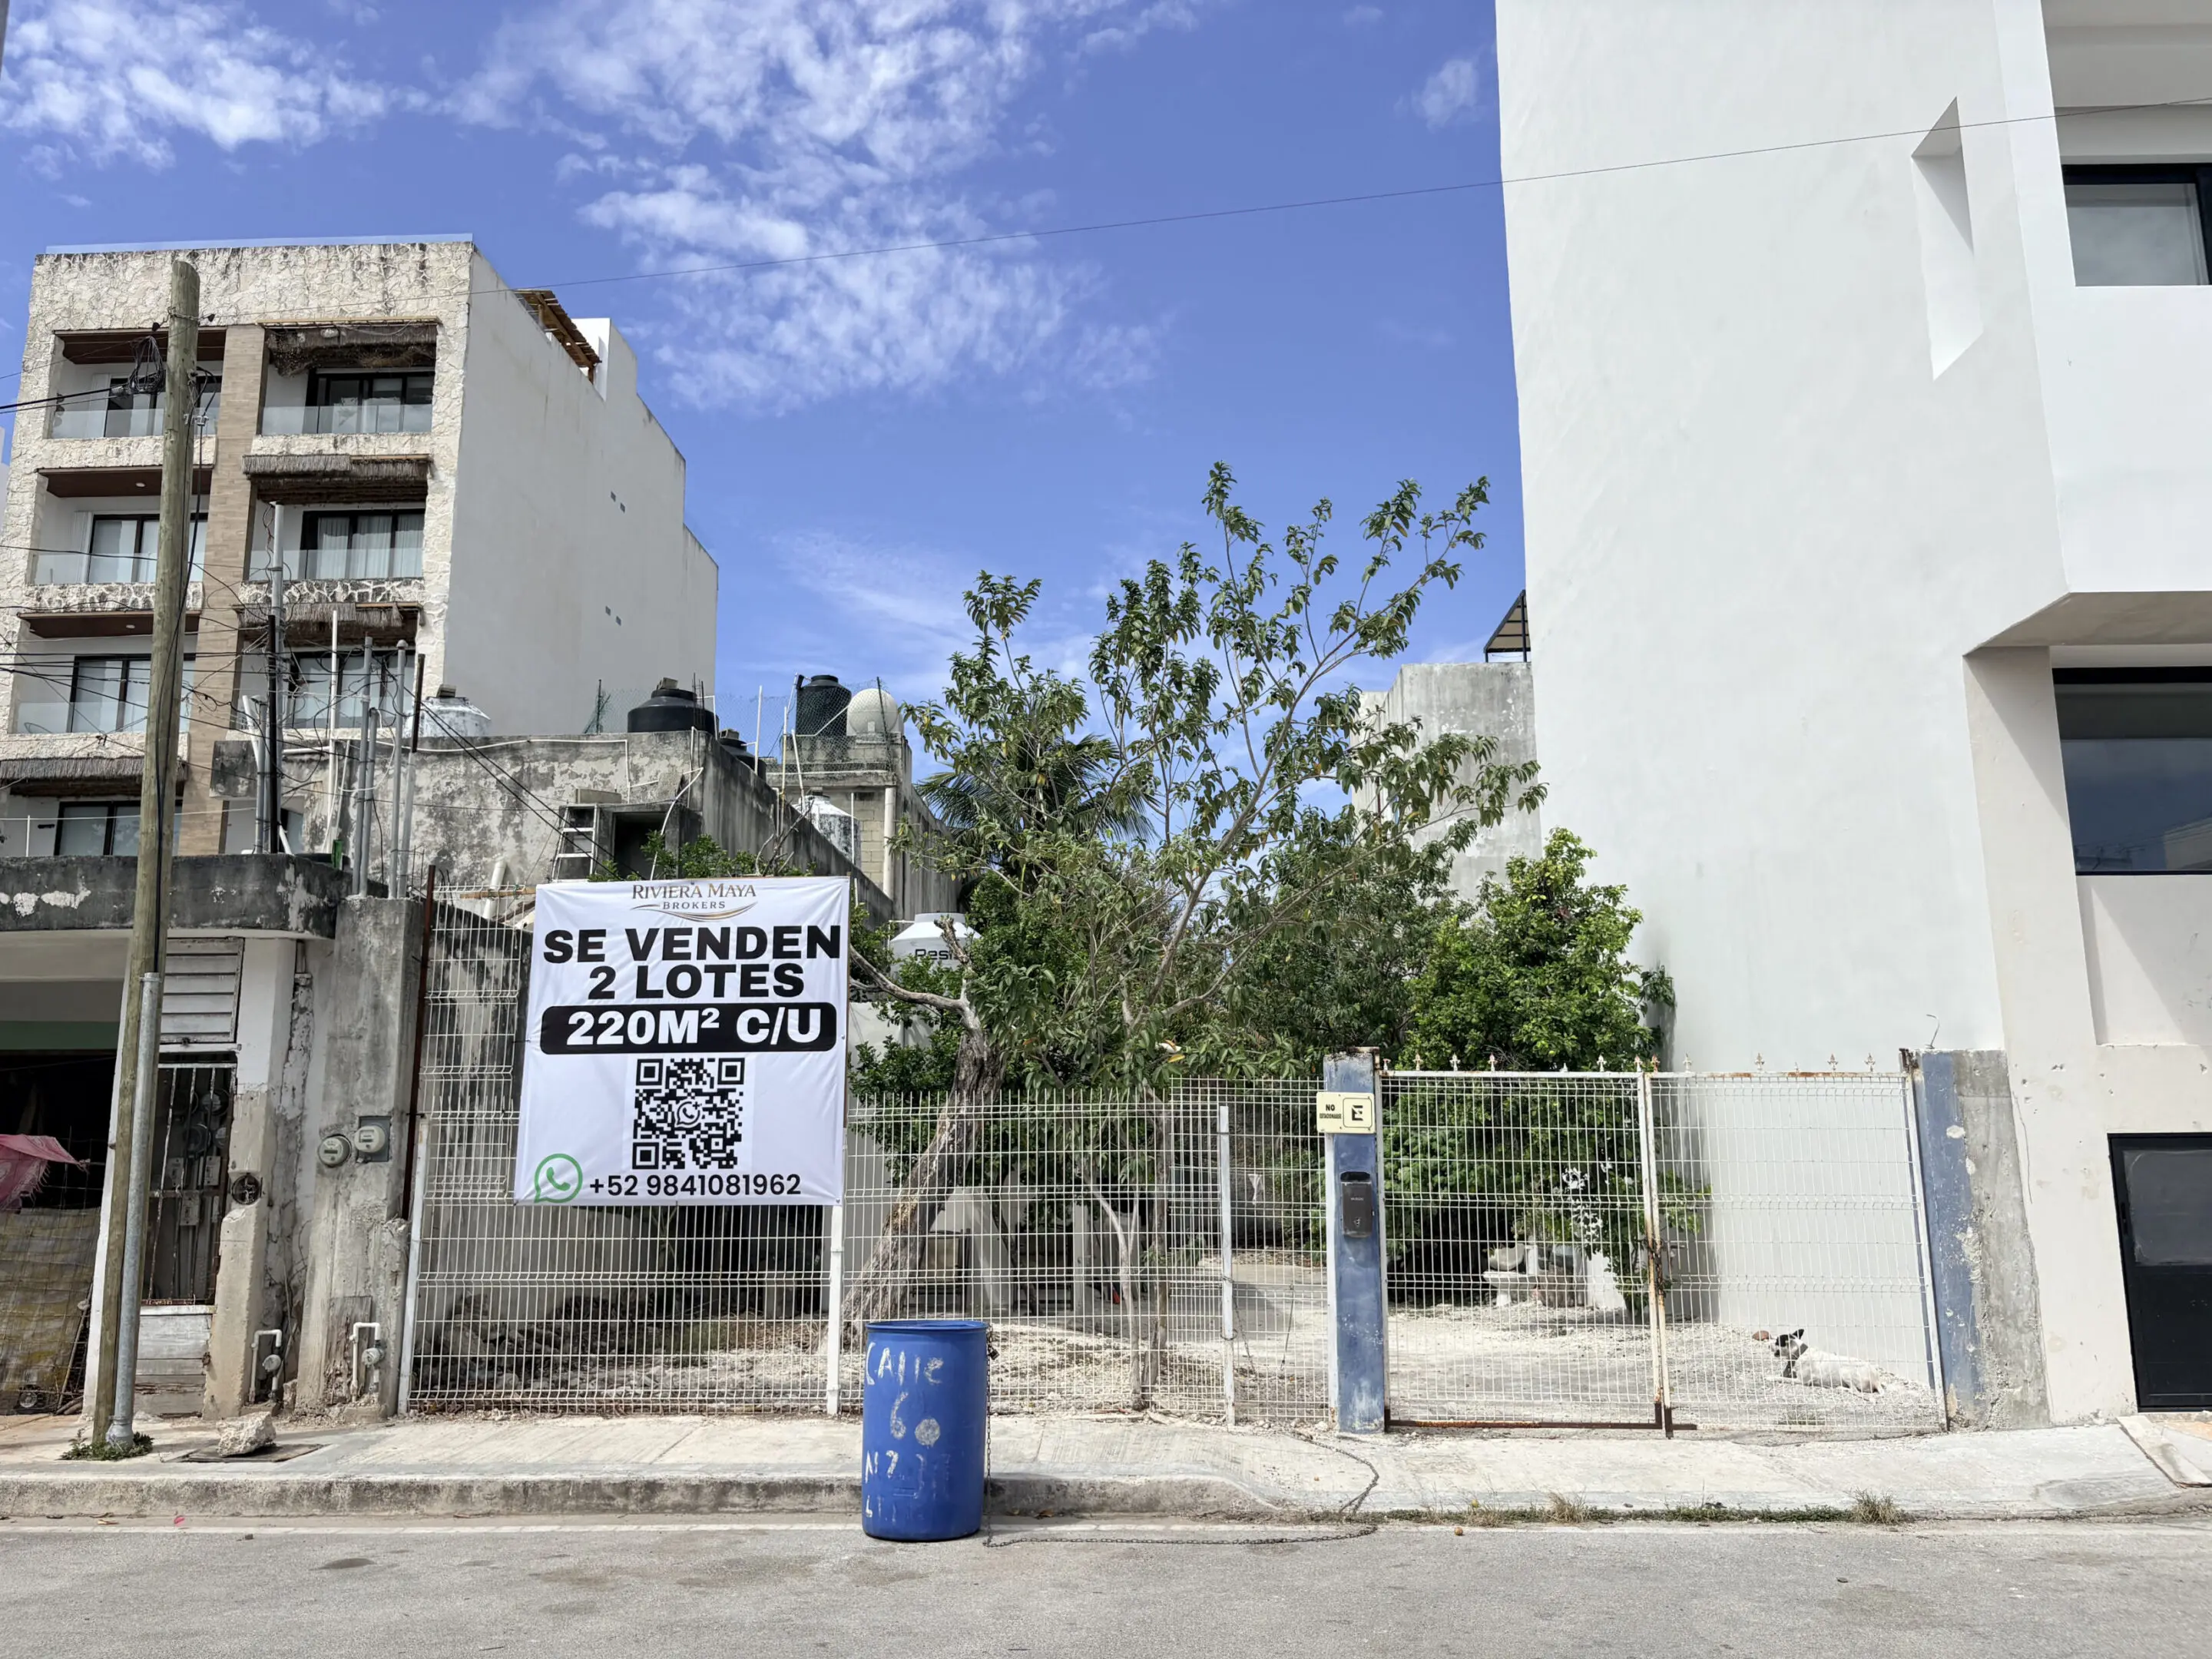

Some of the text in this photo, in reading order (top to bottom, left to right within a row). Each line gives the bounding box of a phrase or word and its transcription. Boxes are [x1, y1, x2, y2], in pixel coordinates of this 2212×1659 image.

[632, 883, 757, 899] RIVIERA MAYA
[663, 901, 726, 910] BROKERS
[543, 925, 840, 964] SE VENDEN
[588, 962, 804, 999] 2 LOTES
[566, 1006, 821, 1045] 220M² C/U
[590, 1174, 801, 1196] +52 9841081962
